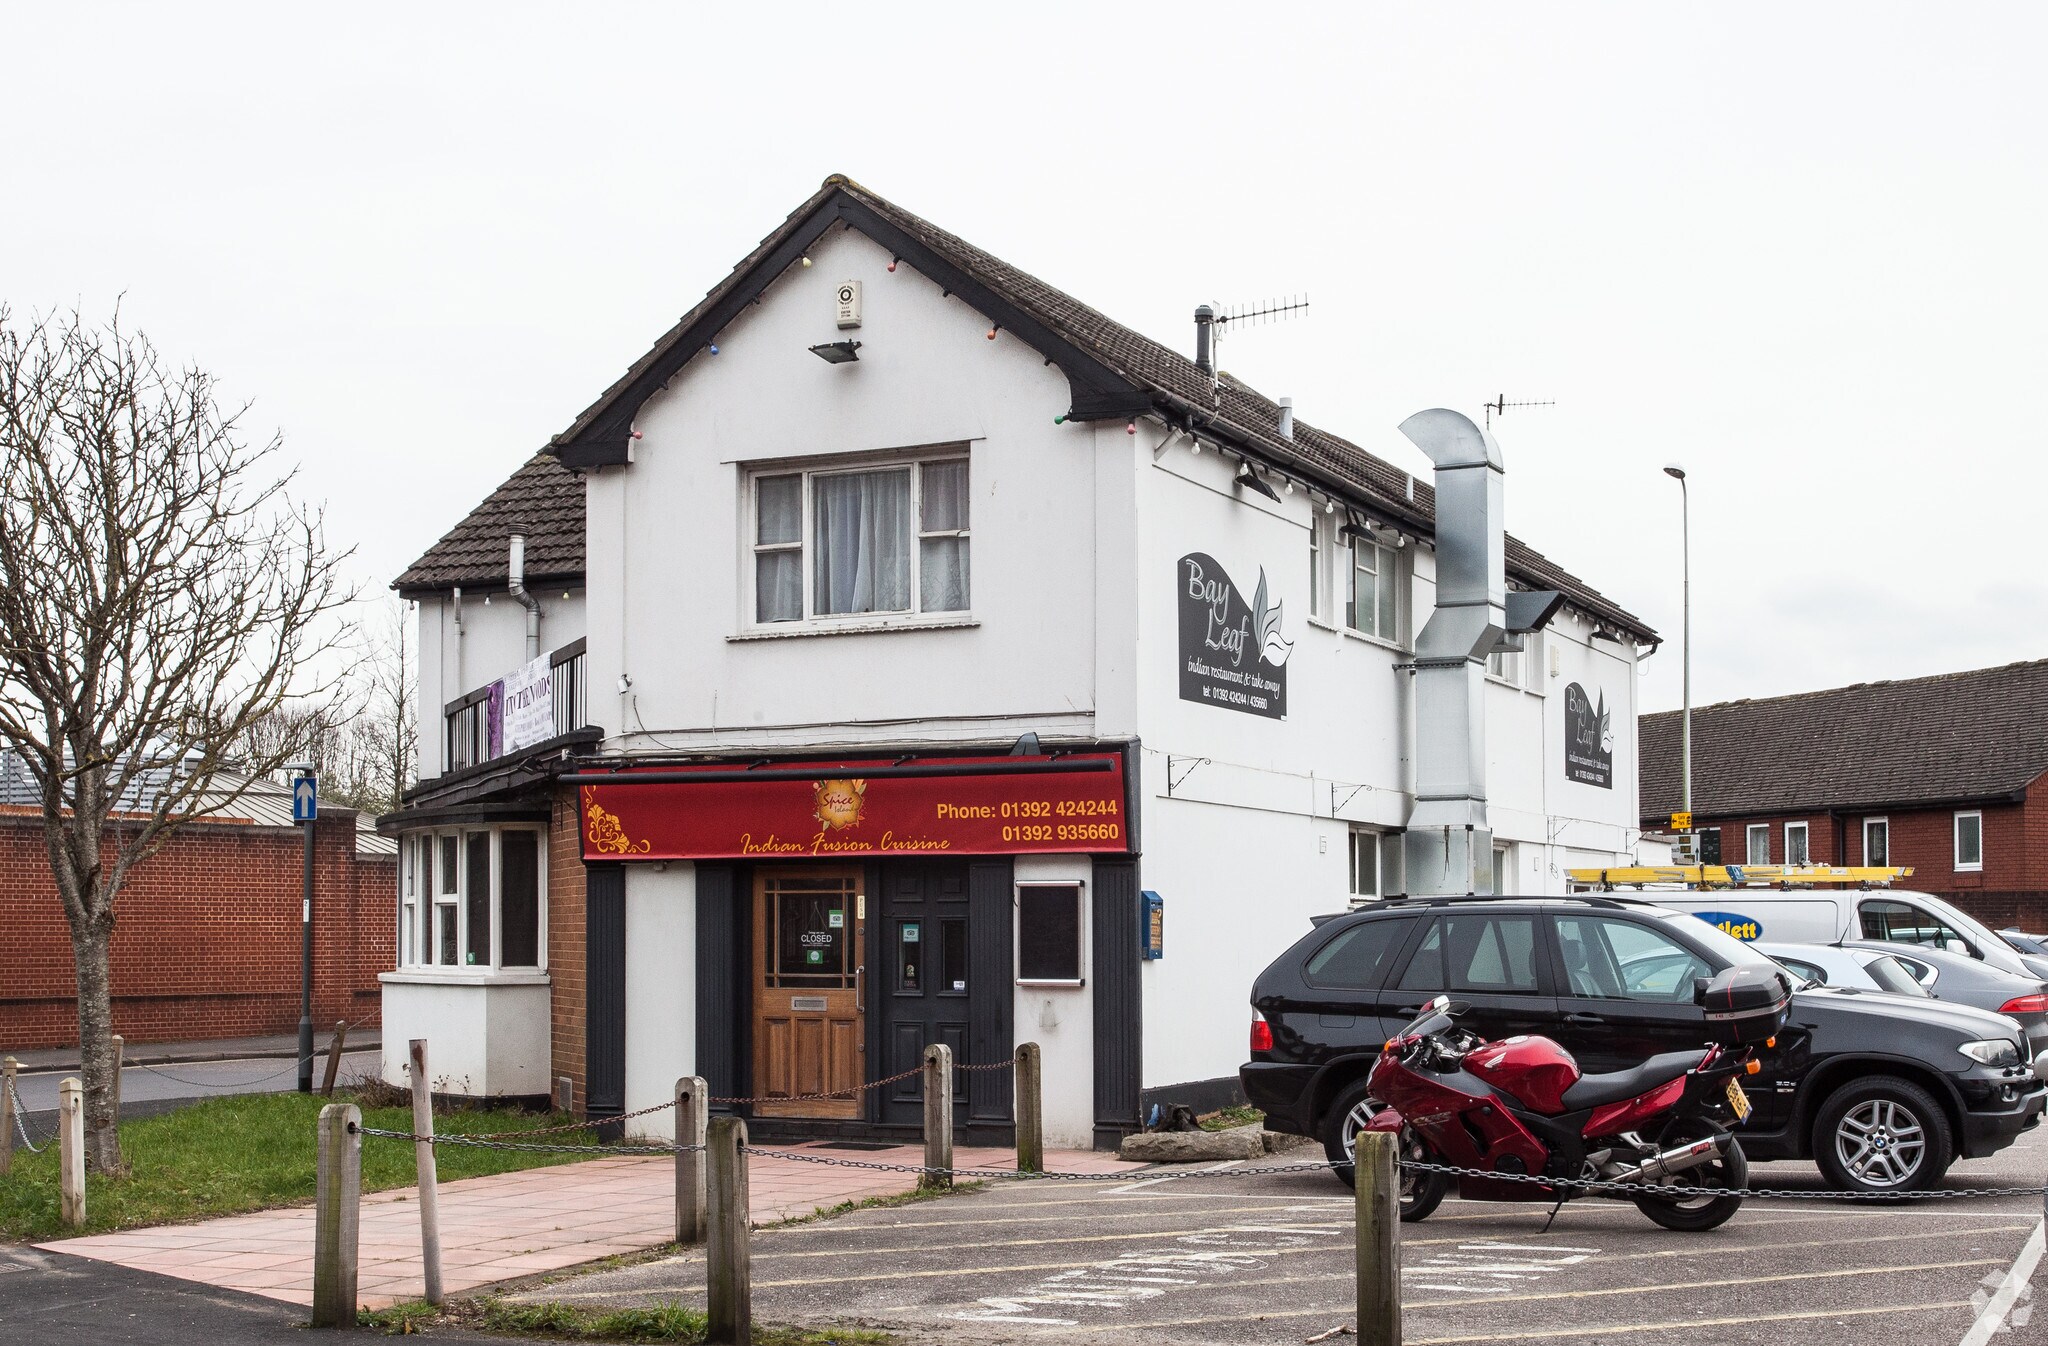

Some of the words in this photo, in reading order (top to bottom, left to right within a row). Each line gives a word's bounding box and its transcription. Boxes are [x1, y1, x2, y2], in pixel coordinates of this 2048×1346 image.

[1185, 558, 1229, 625] Bay
[1205, 608, 1250, 667] Leaf
[1211, 666, 1243, 684] restaurant
[1243, 672, 1251, 686] &
[1251, 672, 1264, 688] take
[1264, 682, 1280, 700] away
[1212, 687, 1228, 701] 01392
[1228, 691, 1247, 705] 424244
[1568, 686, 1587, 727] Bay
[1576, 718, 1595, 756] Leaf
[822, 792, 854, 809] Spice
[937, 803, 996, 819] Phone:
[1001, 801, 1051, 818] 01392
[1055, 799, 1118, 817] 424244
[740, 833, 804, 854] Indian
[810, 832, 873, 856] Fusion
[880, 830, 950, 851] Cuisine
[1002, 825, 1053, 841] 01392
[1057, 823, 1119, 840] 935660
[801, 934, 833, 943] CLOSED
